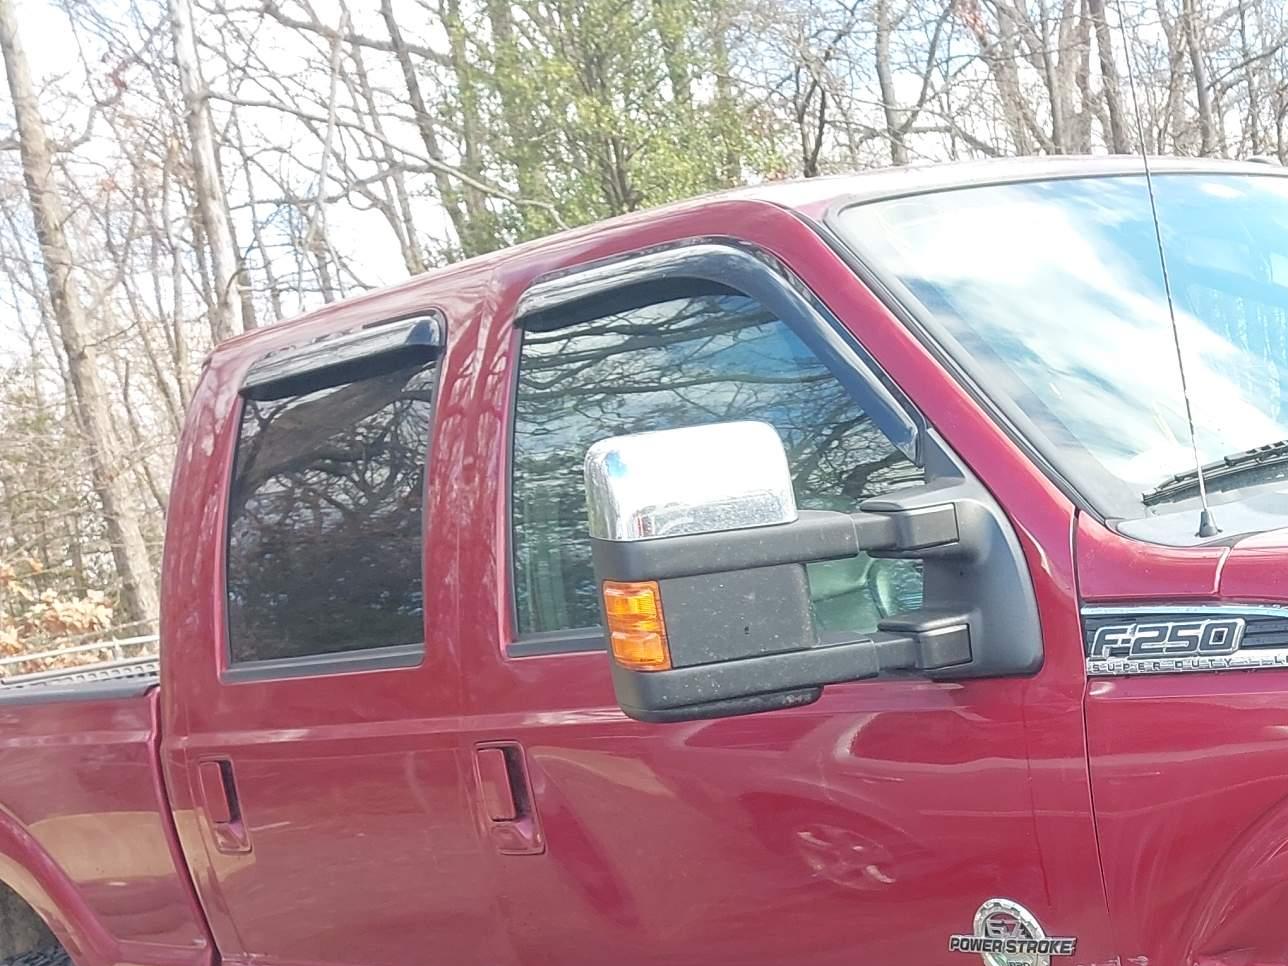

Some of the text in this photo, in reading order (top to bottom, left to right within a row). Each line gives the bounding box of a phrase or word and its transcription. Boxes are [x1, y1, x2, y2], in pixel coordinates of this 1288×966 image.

[1090, 617, 1246, 661] F-250
[1092, 657, 1233, 673] SUPER DUTY
[950, 937, 1074, 955] POWER STROKE
